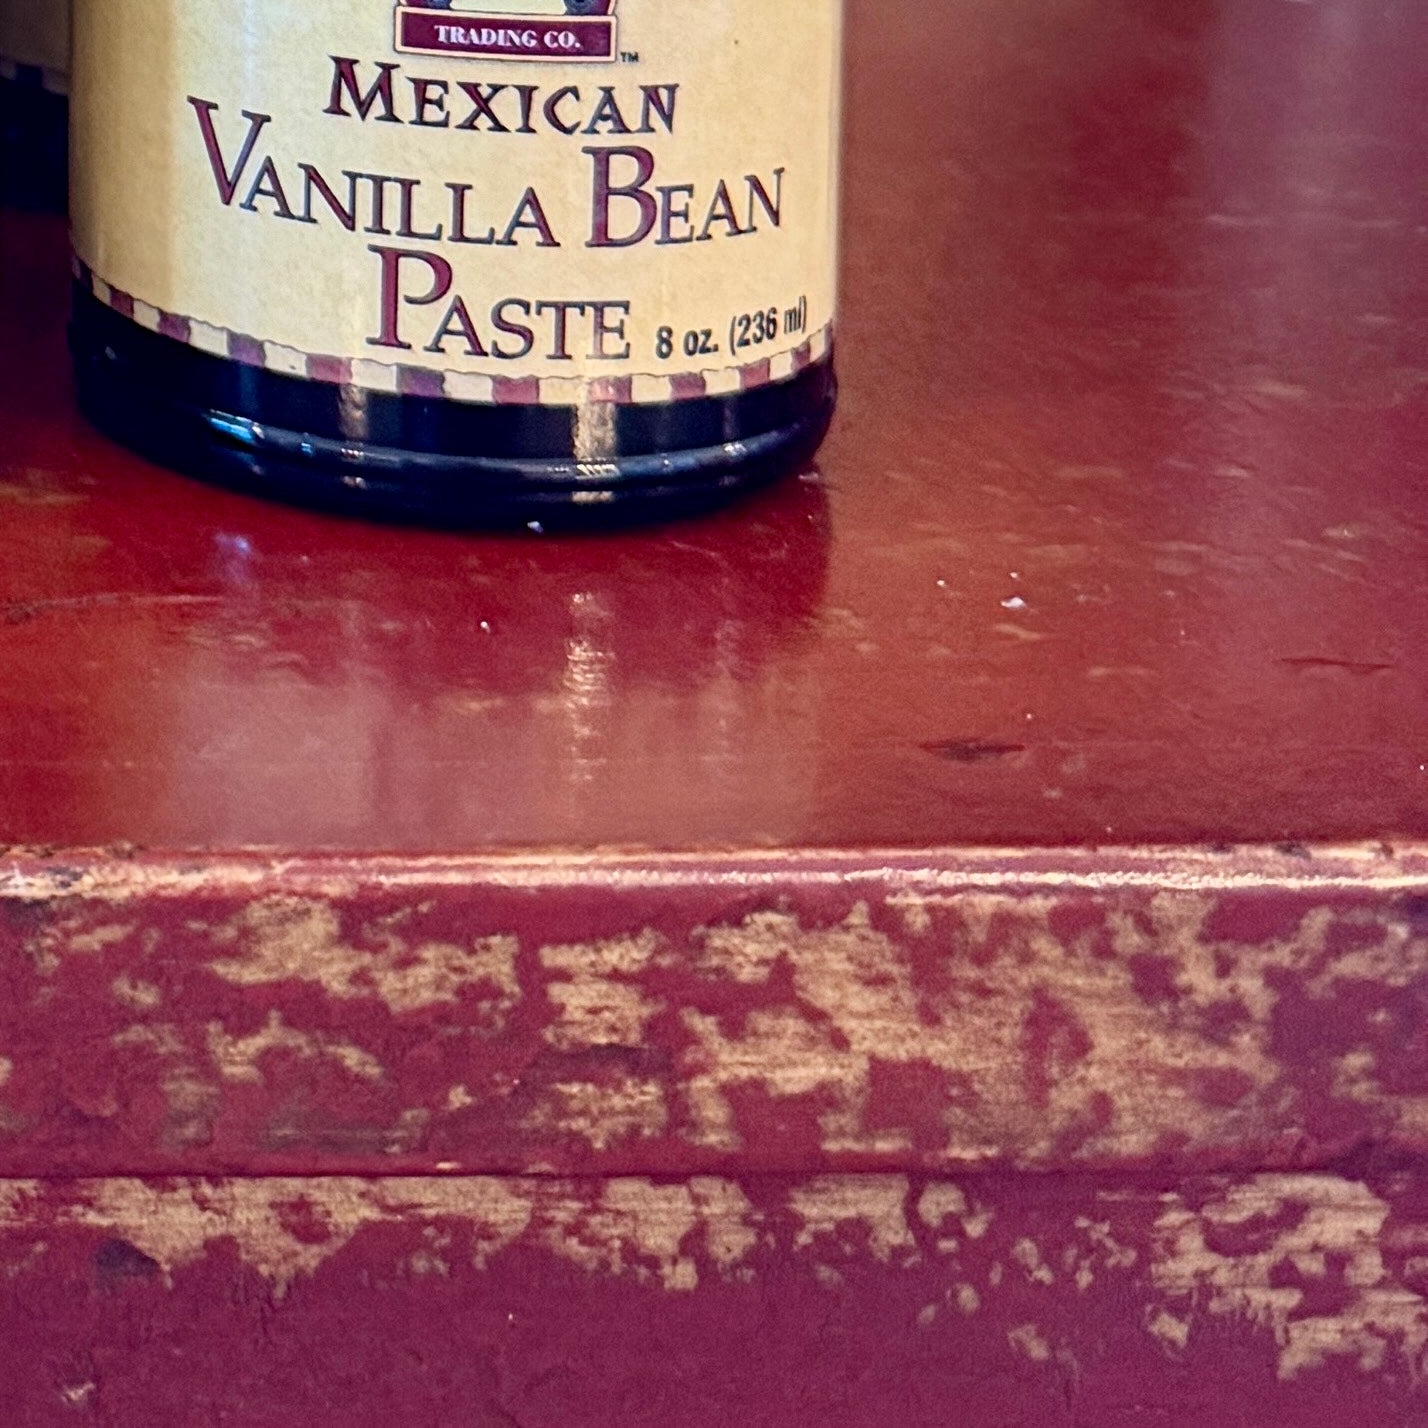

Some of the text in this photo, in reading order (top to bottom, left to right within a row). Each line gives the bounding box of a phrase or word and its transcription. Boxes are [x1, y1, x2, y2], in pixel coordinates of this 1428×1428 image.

[434, 24, 581, 49] TRADING CO.
[620, 52, 639, 63] TM
[322, 54, 680, 136] MEXICAN
[186, 94, 786, 248] VANILLA BEAN
[365, 244, 631, 362] PASTE
[655, 325, 673, 360] 8
[682, 326, 719, 357] oz.
[728, 307, 778, 355] (236
